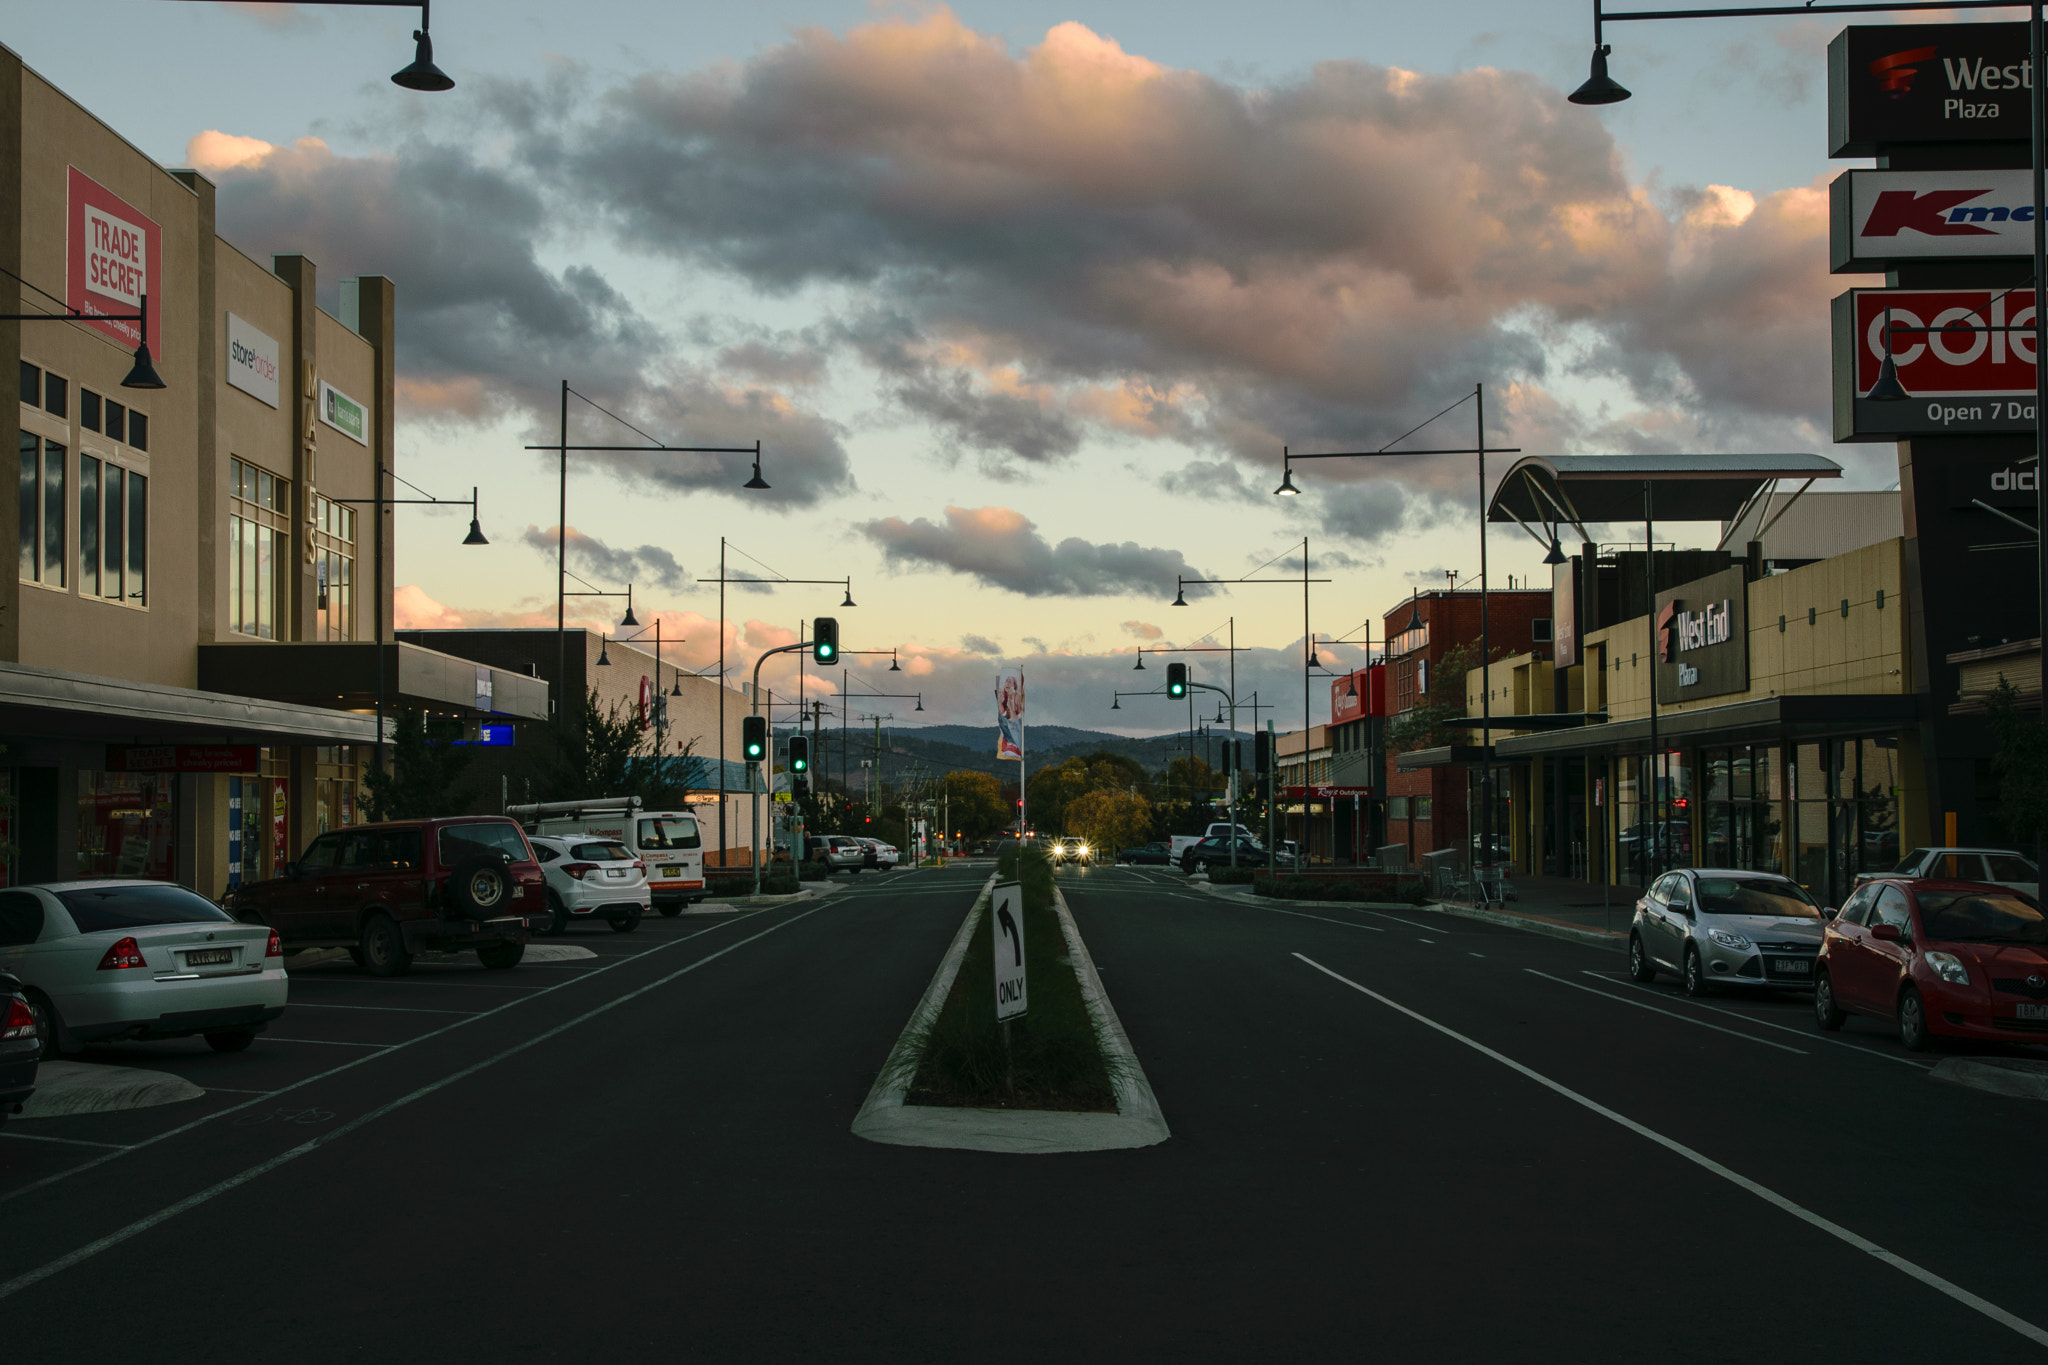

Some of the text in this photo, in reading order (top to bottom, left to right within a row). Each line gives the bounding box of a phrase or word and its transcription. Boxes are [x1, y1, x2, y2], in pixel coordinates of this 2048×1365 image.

[1943, 56, 2033, 91] West
[1944, 98, 2000, 119] Plaza
[1860, 189, 2036, 237] Kma
[91, 216, 139, 264] TRADE
[90, 252, 143, 298] SECRET
[1867, 290, 2037, 367] cole
[1927, 401, 2038, 426] Open 7 Da
[302, 358, 317, 565] MATES
[1990, 466, 2039, 491] dic
[1677, 599, 1729, 652] West End
[1678, 662, 1698, 687] Plaza
[128, 758, 174, 768] SECRET
[132, 748, 171, 758] TRADE
[183, 758, 243, 769] cheeky prices!
[189, 748, 234, 759] Big brands,
[1317, 787, 1339, 798] Ray's
[999, 976, 1023, 1005] ONLY
